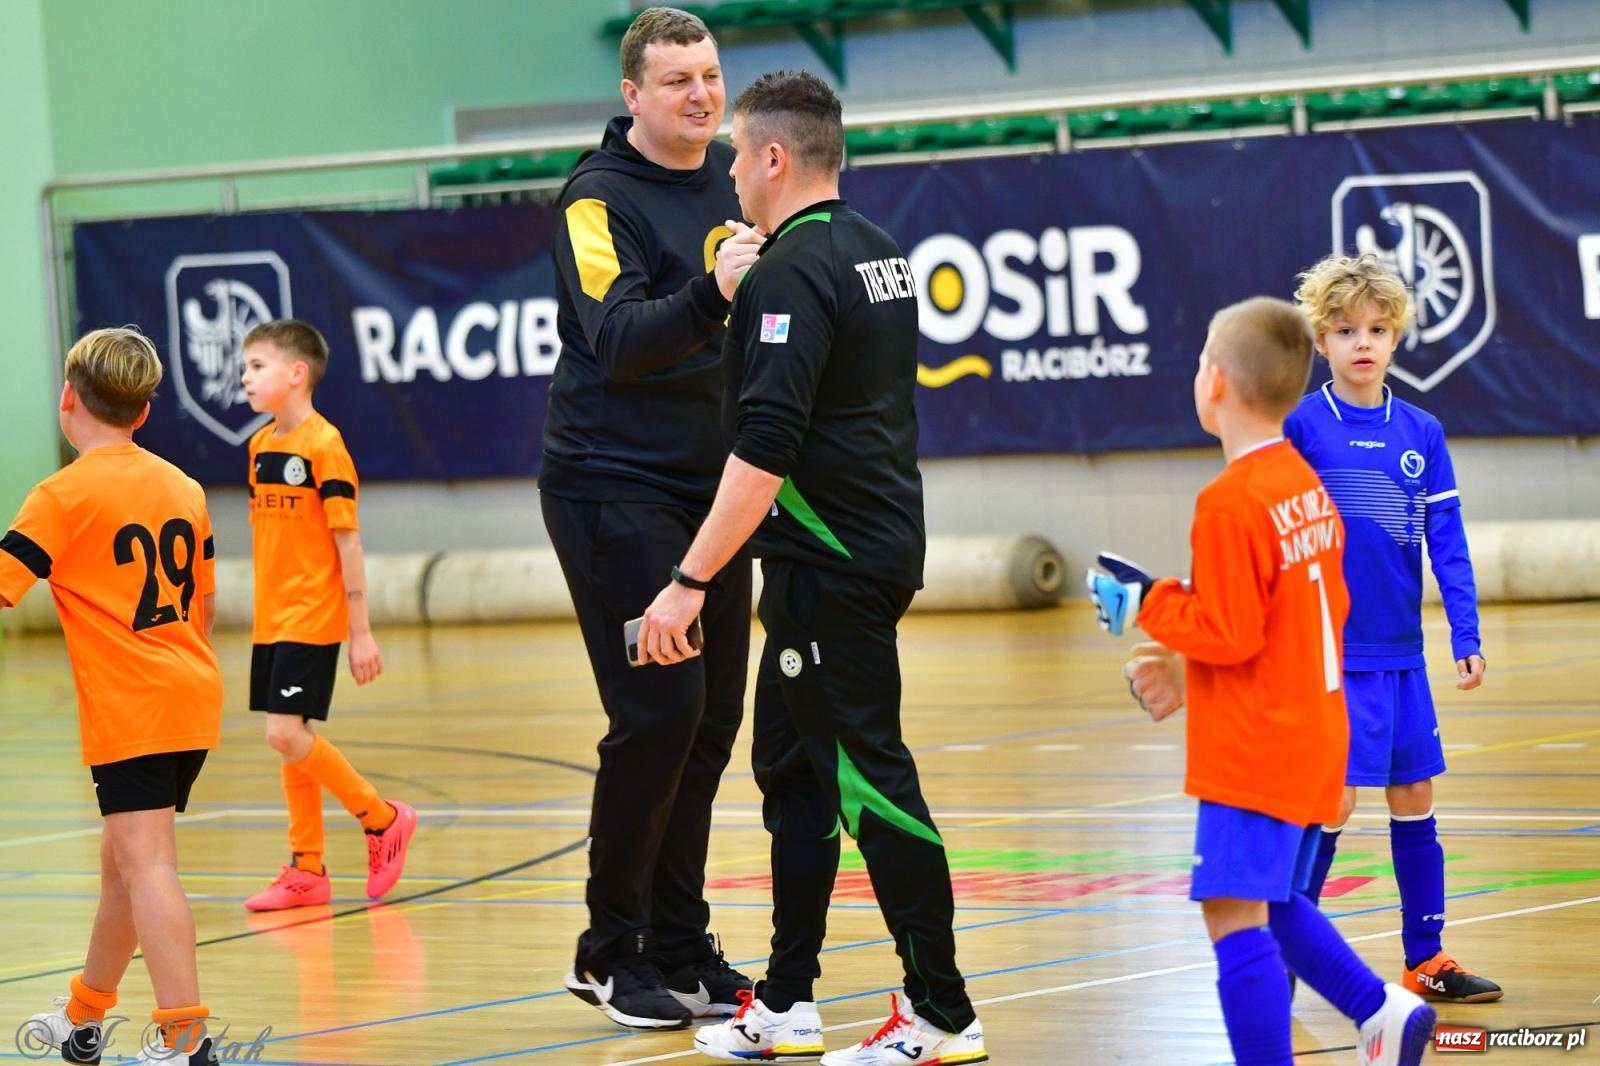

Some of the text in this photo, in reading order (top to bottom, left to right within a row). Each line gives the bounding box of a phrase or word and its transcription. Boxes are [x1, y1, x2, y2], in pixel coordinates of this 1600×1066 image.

[854, 257, 917, 304] TRENER
[1001, 337, 1151, 382] RACIBÓRZ
[1349, 440, 1386, 449] regio
[113, 518, 196, 632] 29
[1308, 561, 1340, 693] 1
[1416, 973, 1446, 992] FILA
